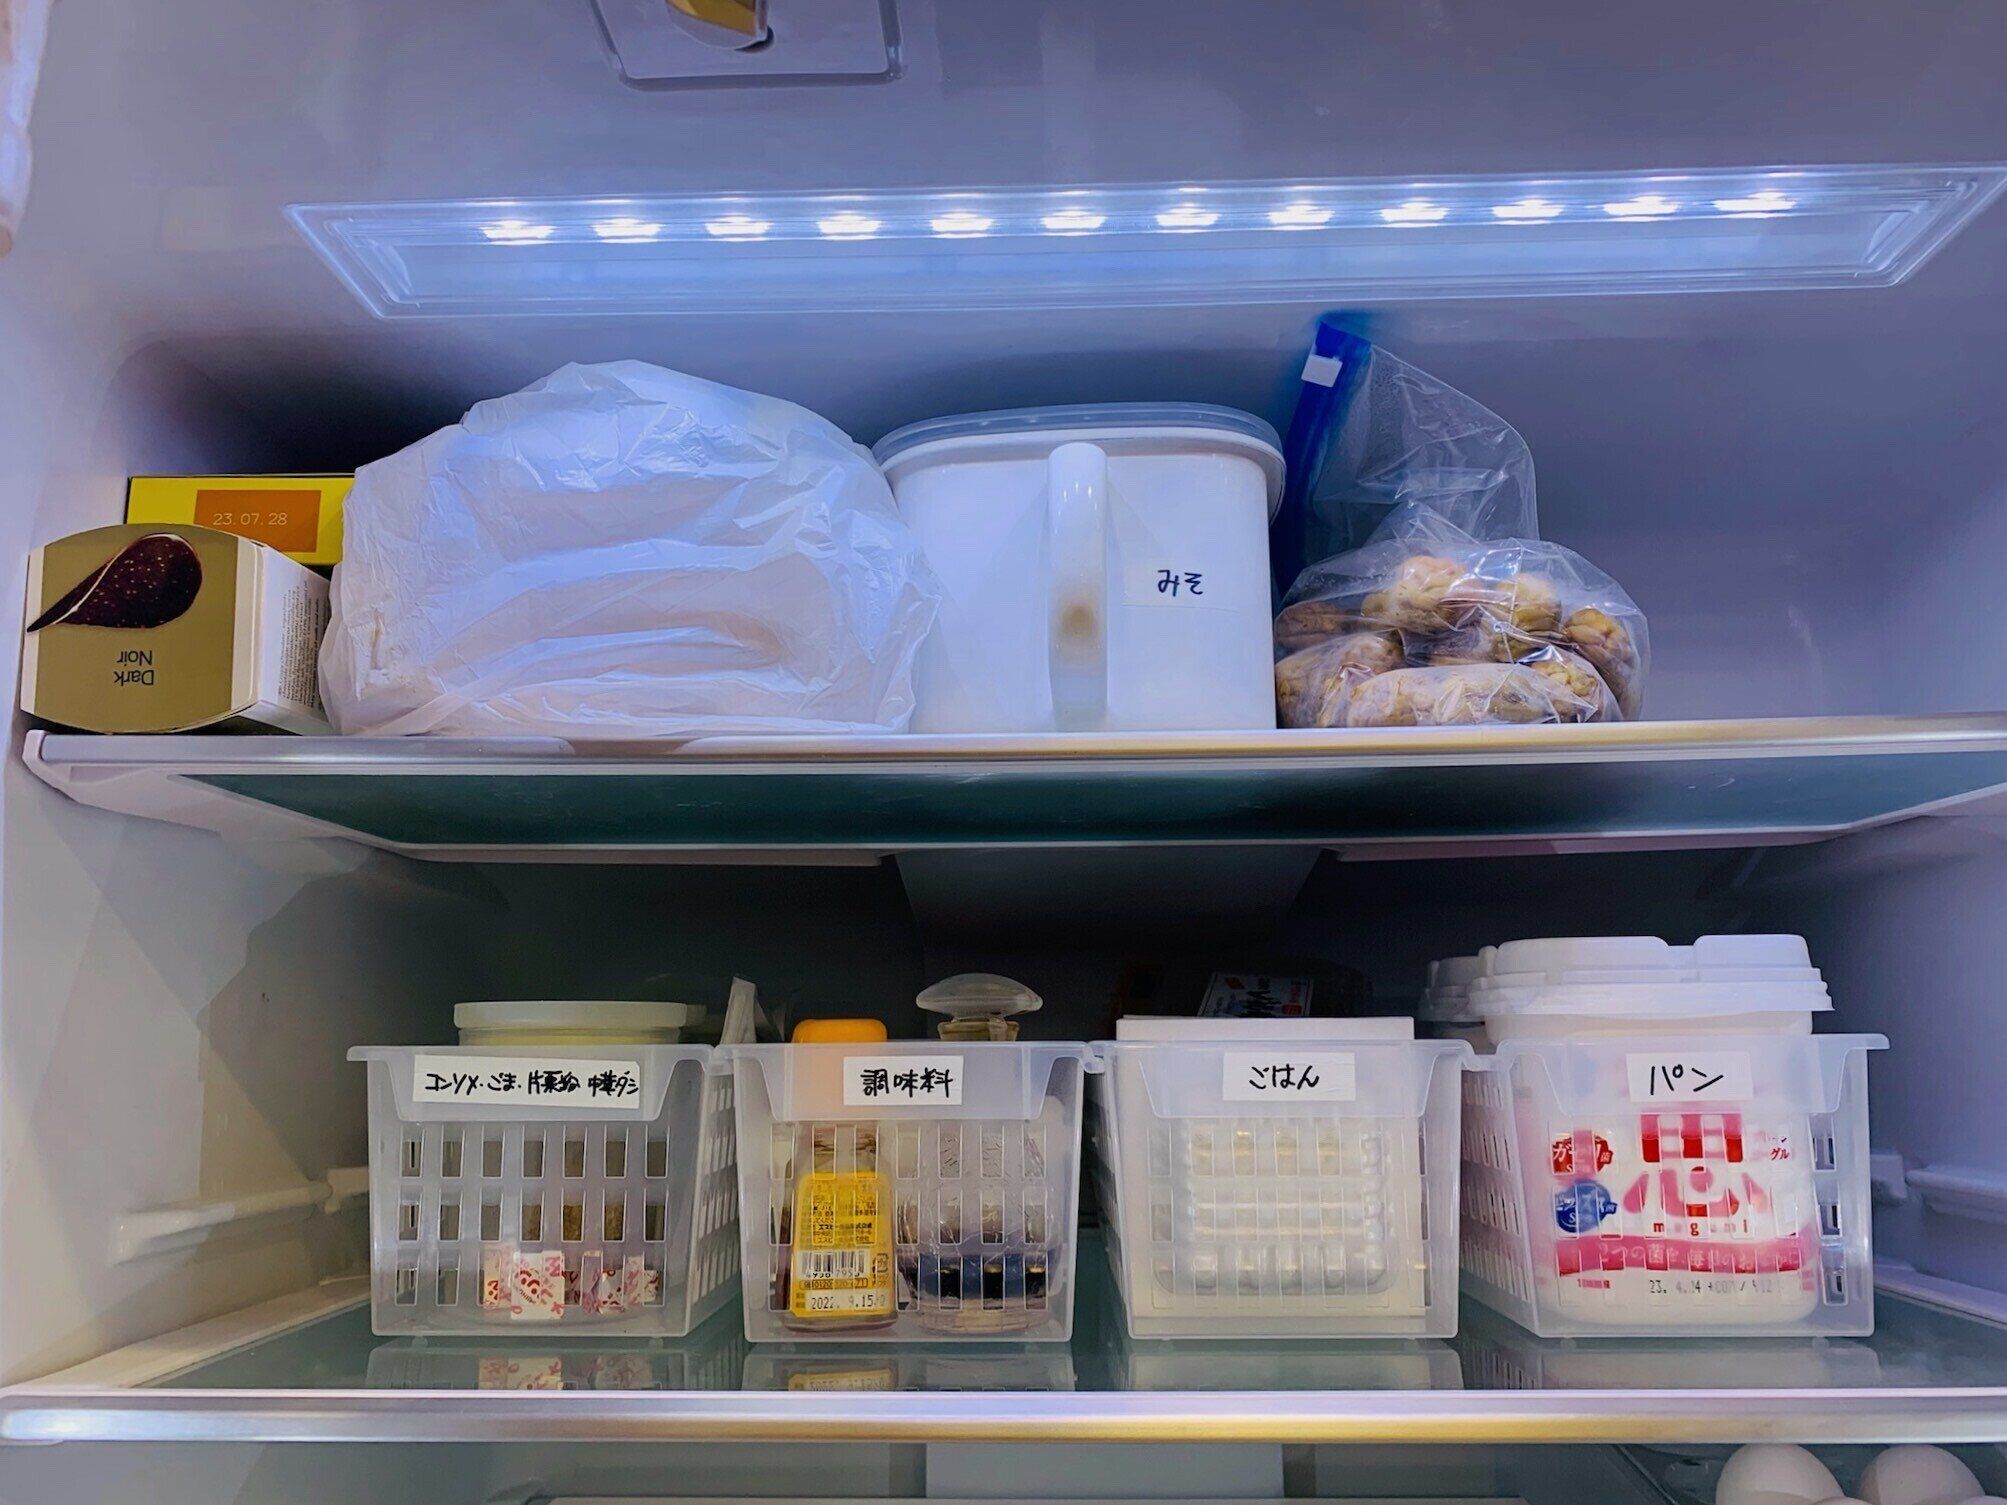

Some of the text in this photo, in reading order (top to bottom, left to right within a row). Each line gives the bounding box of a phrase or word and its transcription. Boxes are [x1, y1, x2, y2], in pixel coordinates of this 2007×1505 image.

[1157, 569, 1204, 597] みそ
[116, 649, 153, 667] Noir
[113, 669, 155, 687] Dark
[860, 1067, 954, 1098] 調味料
[1248, 1063, 1320, 1090] ごはん
[1649, 1063, 1724, 1096] パン
